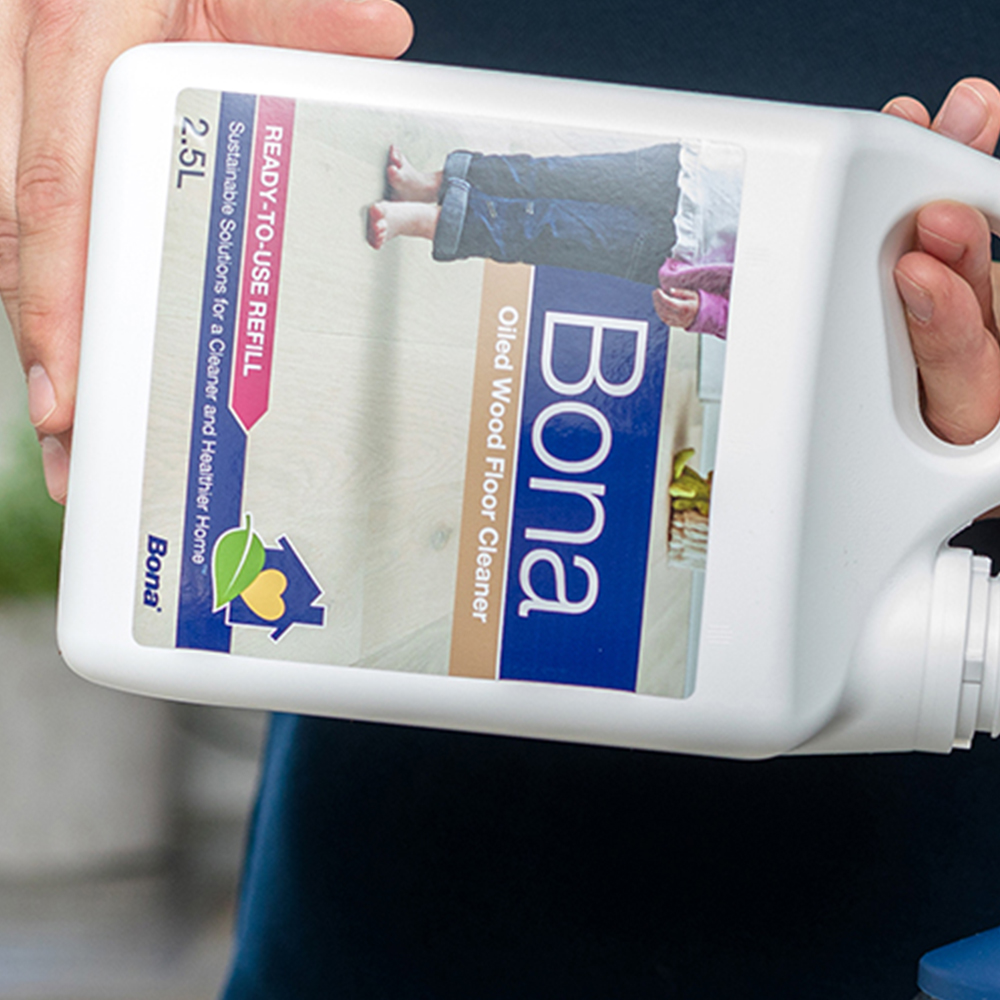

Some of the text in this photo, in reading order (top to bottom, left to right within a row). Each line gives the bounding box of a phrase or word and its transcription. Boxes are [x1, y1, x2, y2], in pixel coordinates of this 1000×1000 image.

[176, 116, 209, 189] 2.5L
[221, 120, 246, 216] Sustainable
[214, 219, 237, 294] Solutions
[243, 124, 283, 377] READY-TO-USE REFILL
[211, 298, 229, 320] for
[211, 324, 223, 335] a
[204, 339, 225, 400] Cleaner
[201, 404, 217, 436] and
[196, 440, 216, 511] Healthier
[472, 306, 519, 623] Oiled Wood Floor Cleaner
[517, 311, 649, 618] Bona
